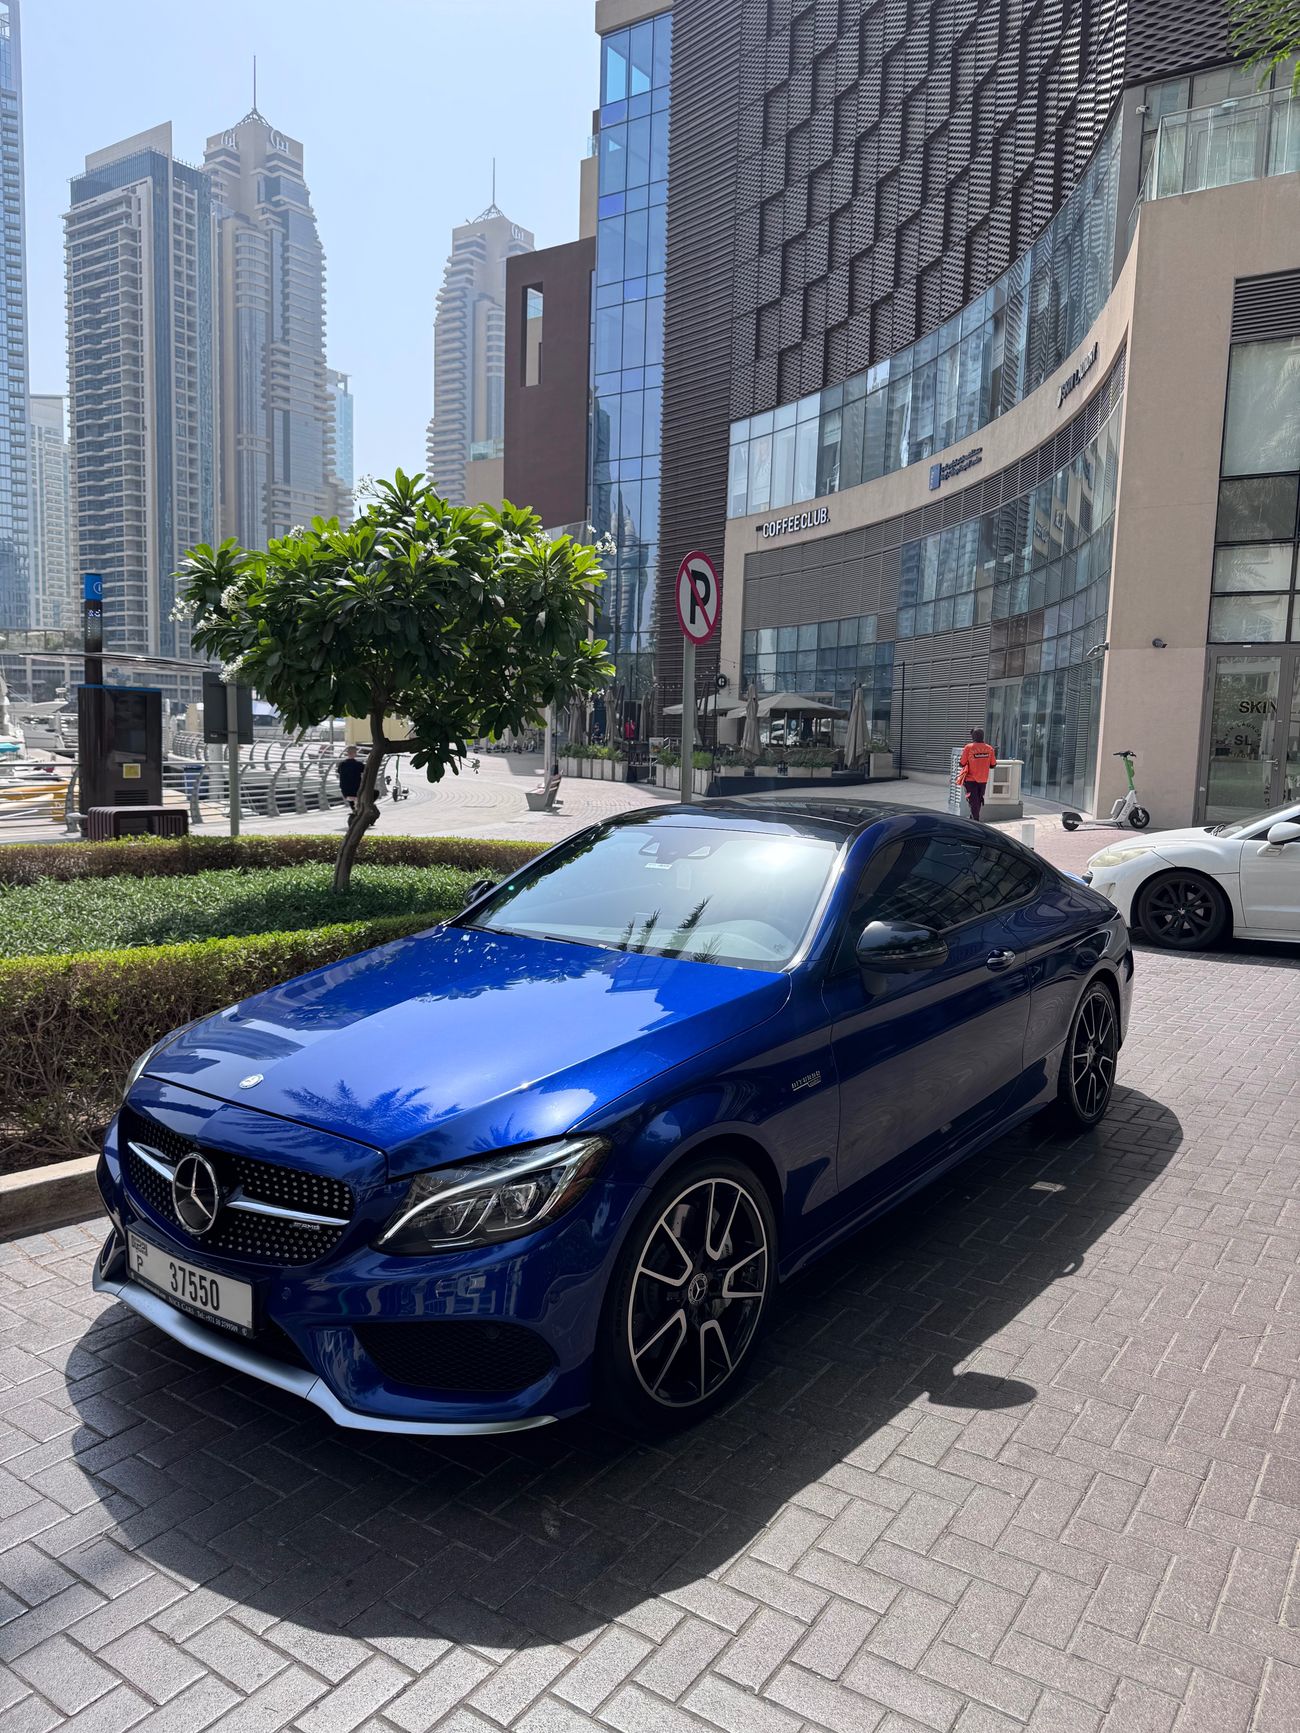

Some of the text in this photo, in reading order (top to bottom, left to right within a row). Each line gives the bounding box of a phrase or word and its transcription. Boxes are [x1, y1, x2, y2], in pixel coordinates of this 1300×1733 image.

[690, 569, 711, 625] P
[1233, 734, 1252, 746] SL
[136, 1254, 144, 1272] P
[169, 1261, 220, 1311] 37550
